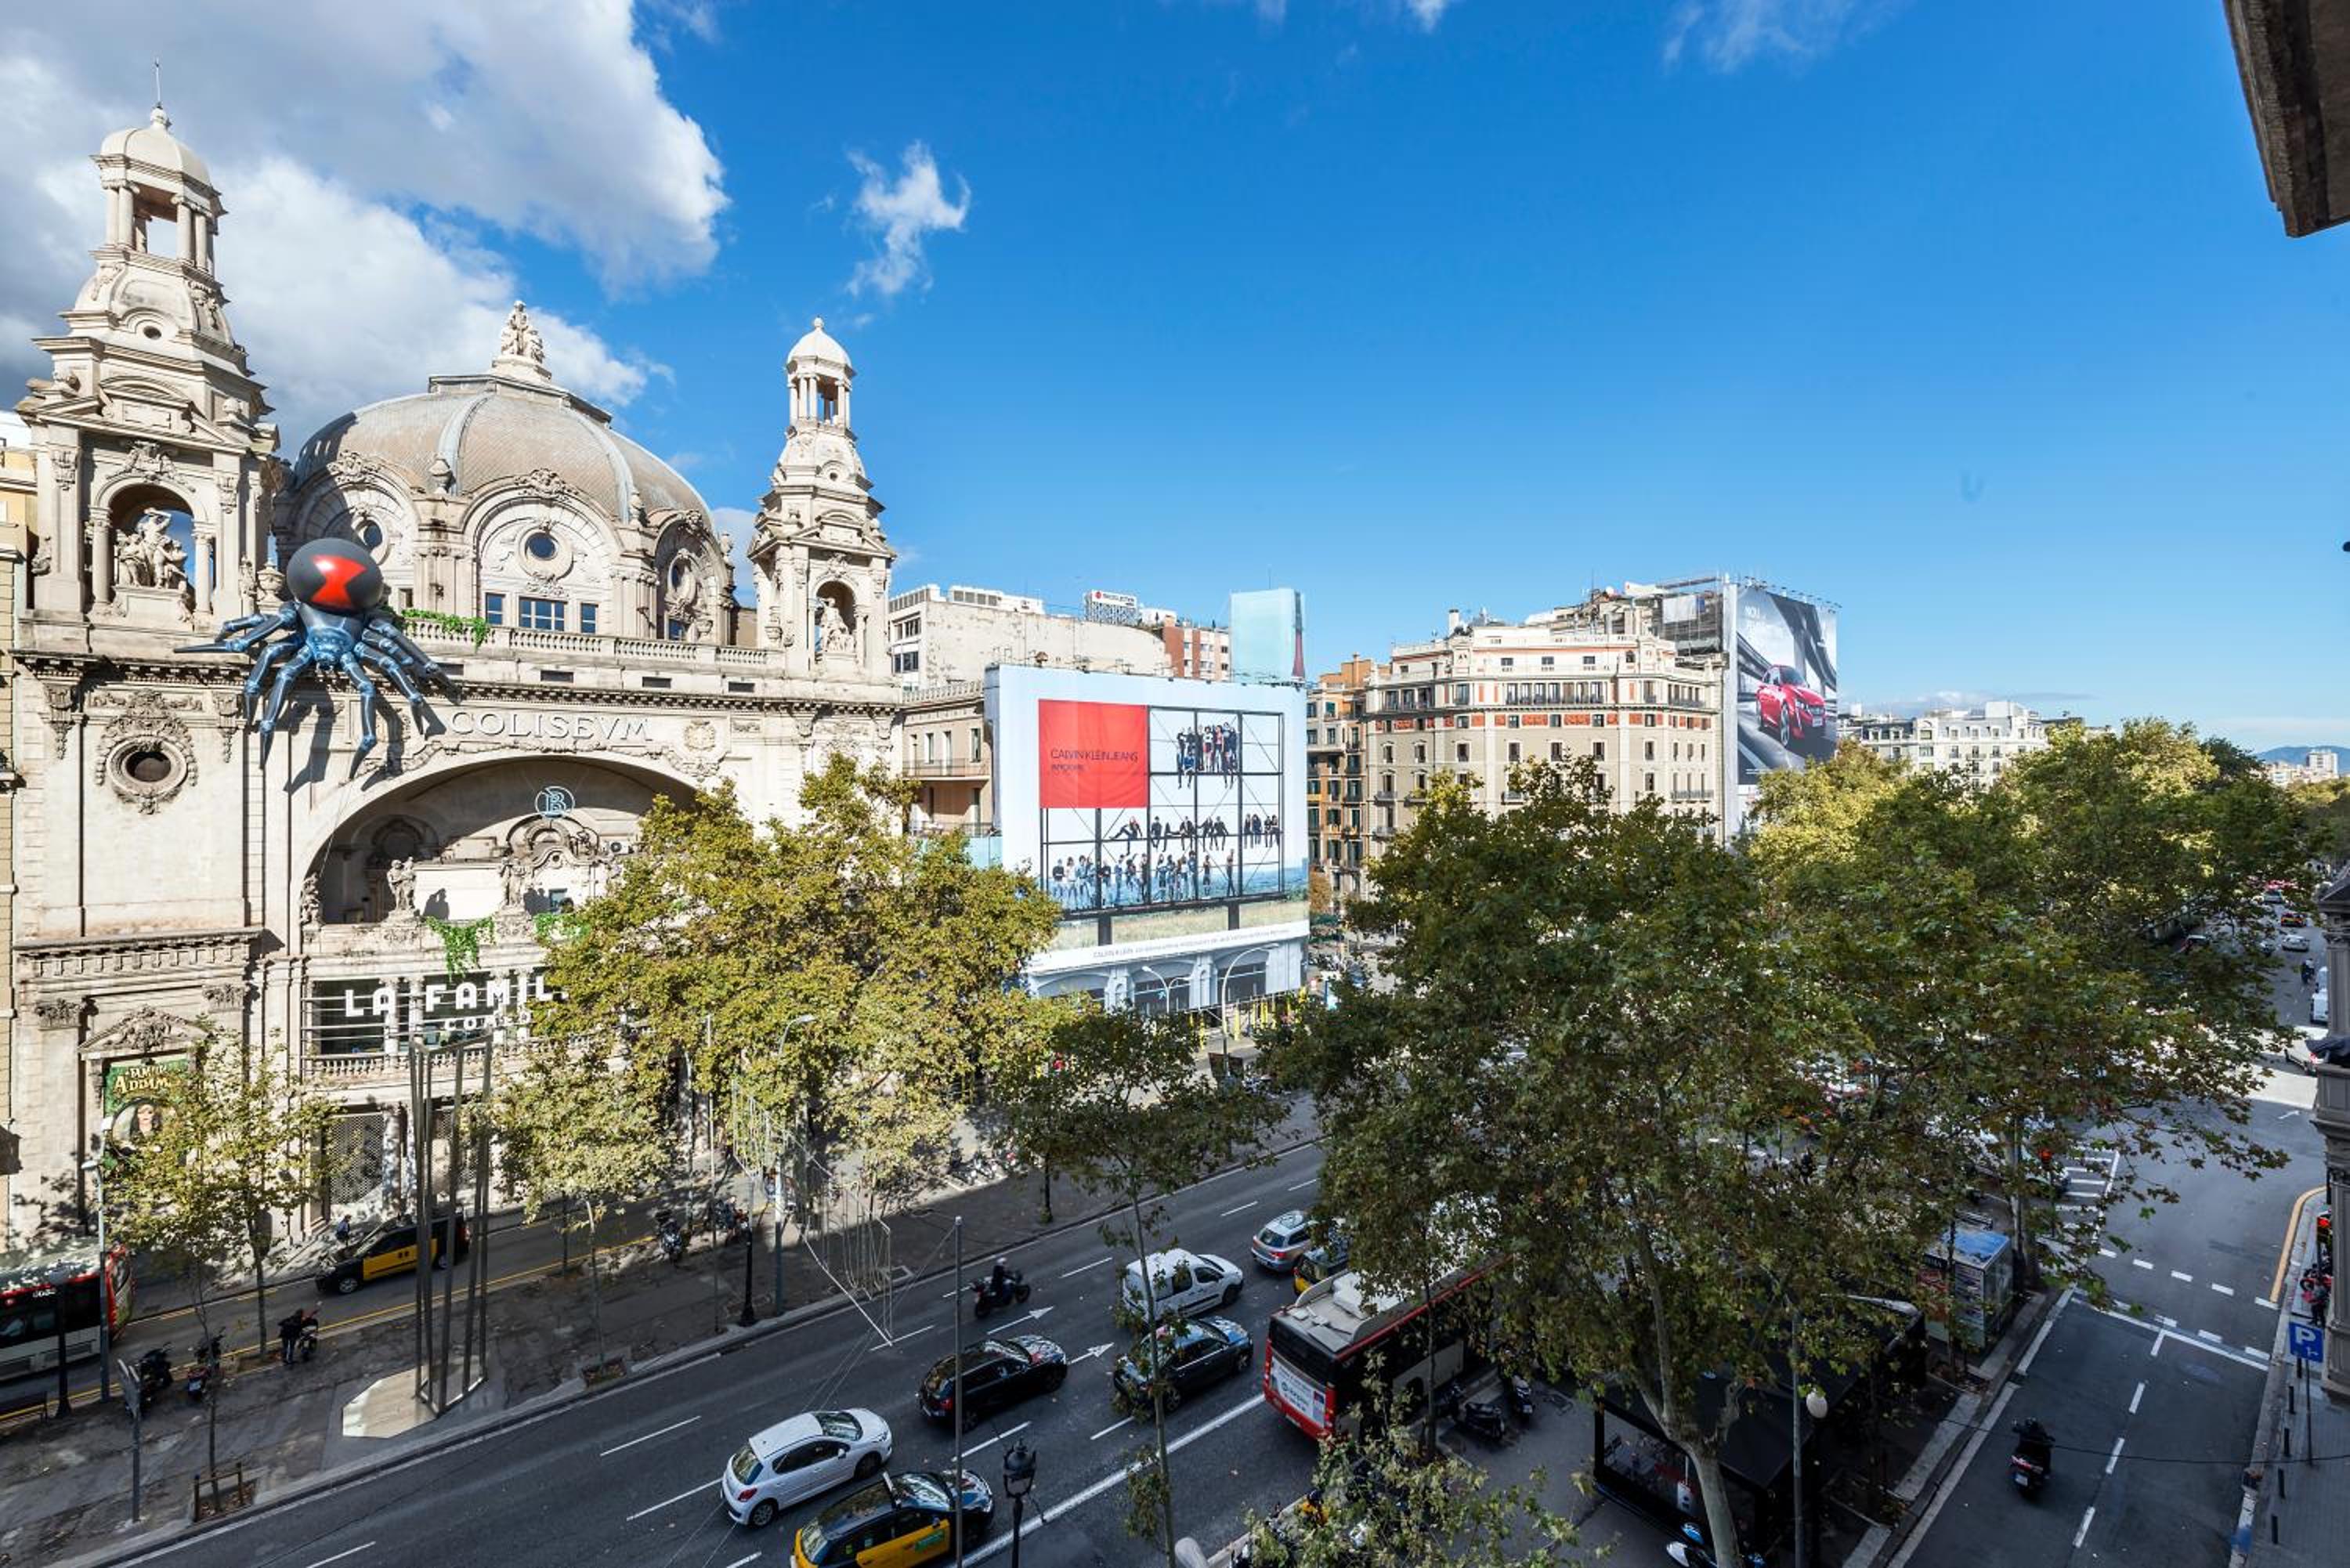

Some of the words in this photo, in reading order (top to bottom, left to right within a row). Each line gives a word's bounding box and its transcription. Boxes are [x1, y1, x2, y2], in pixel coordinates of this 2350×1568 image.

[451, 711, 653, 742] COLISEVM
[1085, 751, 1109, 761] KLEIN
[345, 987, 396, 1017] LA
[425, 976, 570, 1012] FAMIL
[445, 1011, 530, 1031] COMED
[2295, 1326, 2316, 1345] P
